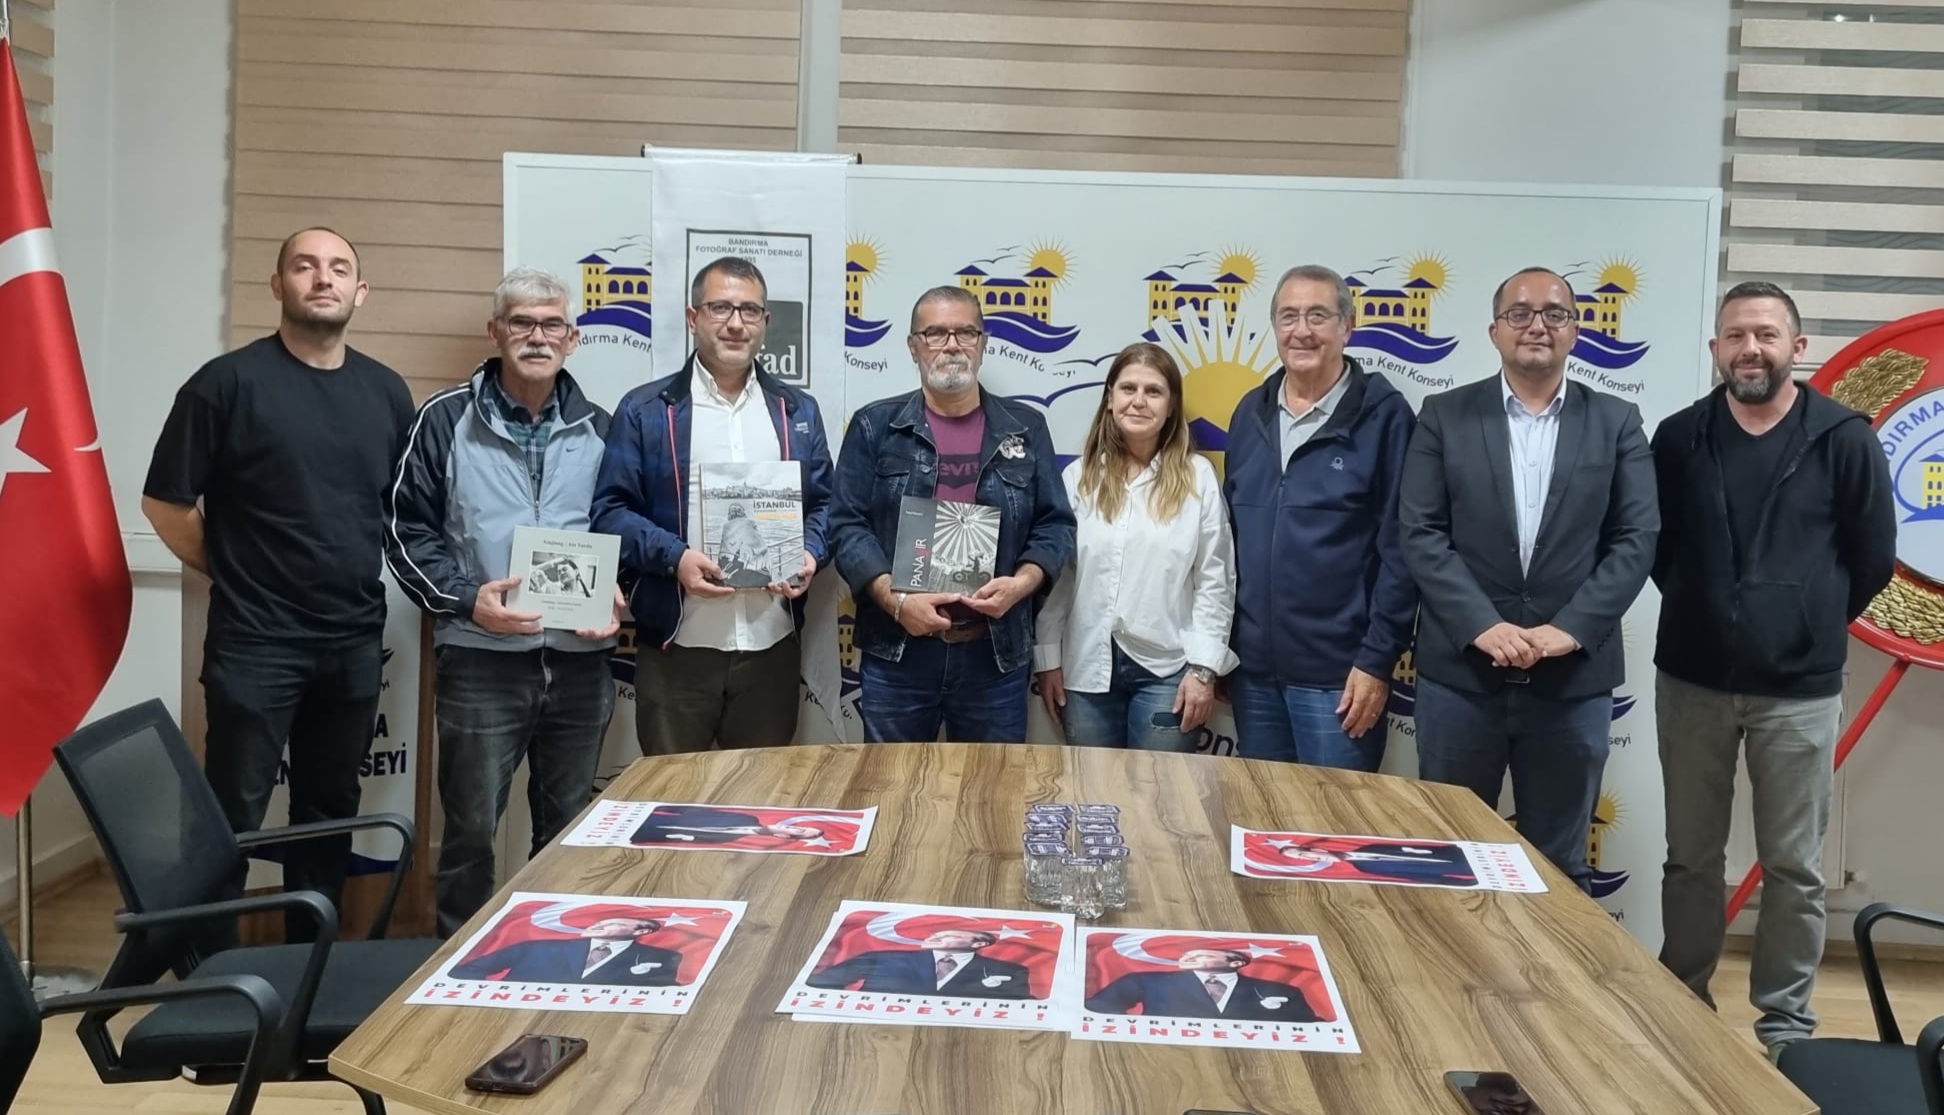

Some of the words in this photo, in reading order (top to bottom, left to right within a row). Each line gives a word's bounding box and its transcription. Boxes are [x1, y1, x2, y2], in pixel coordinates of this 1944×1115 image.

[695, 245, 737, 255] FOTOĞRAF
[738, 247, 766, 256] SANATI
[728, 238, 769, 247] BANDIRMA
[578, 334, 619, 347] dırma
[844, 350, 888, 373] Konseyi
[999, 345, 1029, 364] Kent
[1377, 356, 1407, 375] Kent
[1407, 368, 1454, 389] Konseyi
[1567, 361, 1597, 380] Kent
[1597, 372, 1645, 394] Konseyi
[1882, 400, 1944, 457] DIRMA
[359, 742, 407, 778] SEYİ
[424, 988, 648, 1007] İZİNDEYİZ
[434, 982, 689, 997] DEVRİMLERİNİN
[790, 998, 1010, 1019] İZİNDEYİZ
[796, 991, 1049, 1010] DEVRİMLERİNİN
[1082, 1016, 1344, 1034] DEVRİMLERİNİN
[1082, 1023, 1309, 1043] İZİNDEYİZ
